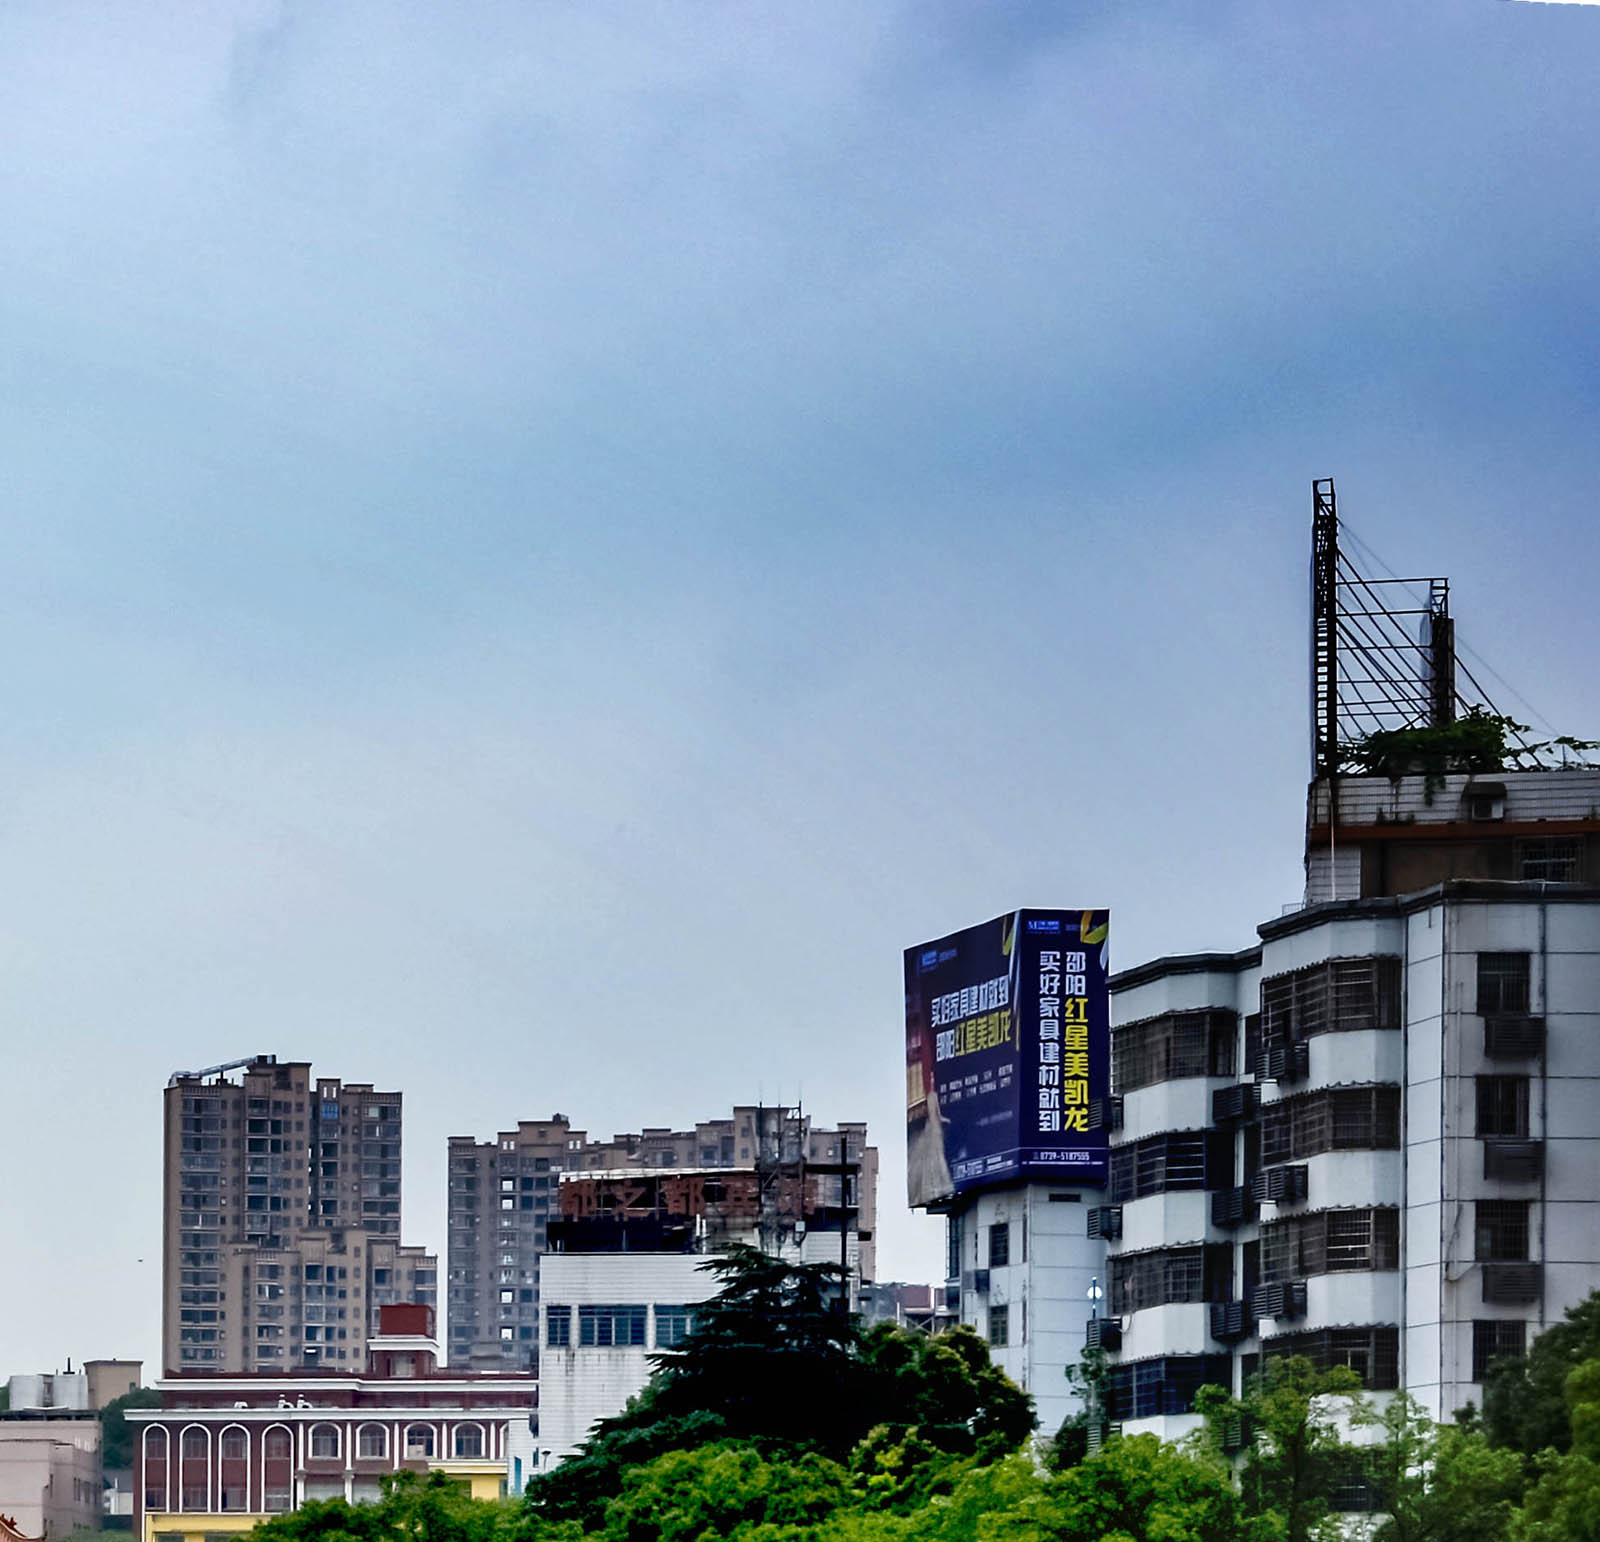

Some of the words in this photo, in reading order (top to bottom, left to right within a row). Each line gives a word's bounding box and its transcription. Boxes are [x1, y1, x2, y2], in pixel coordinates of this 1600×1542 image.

[936, 1008, 1011, 1062] 邵阳红星美凯龙
[1039, 951, 1060, 1132] 买好家具建材就到
[1064, 951, 1088, 1132] 邵阳红星美凯龙
[1040, 1151, 1090, 1161] 0739-5187555
